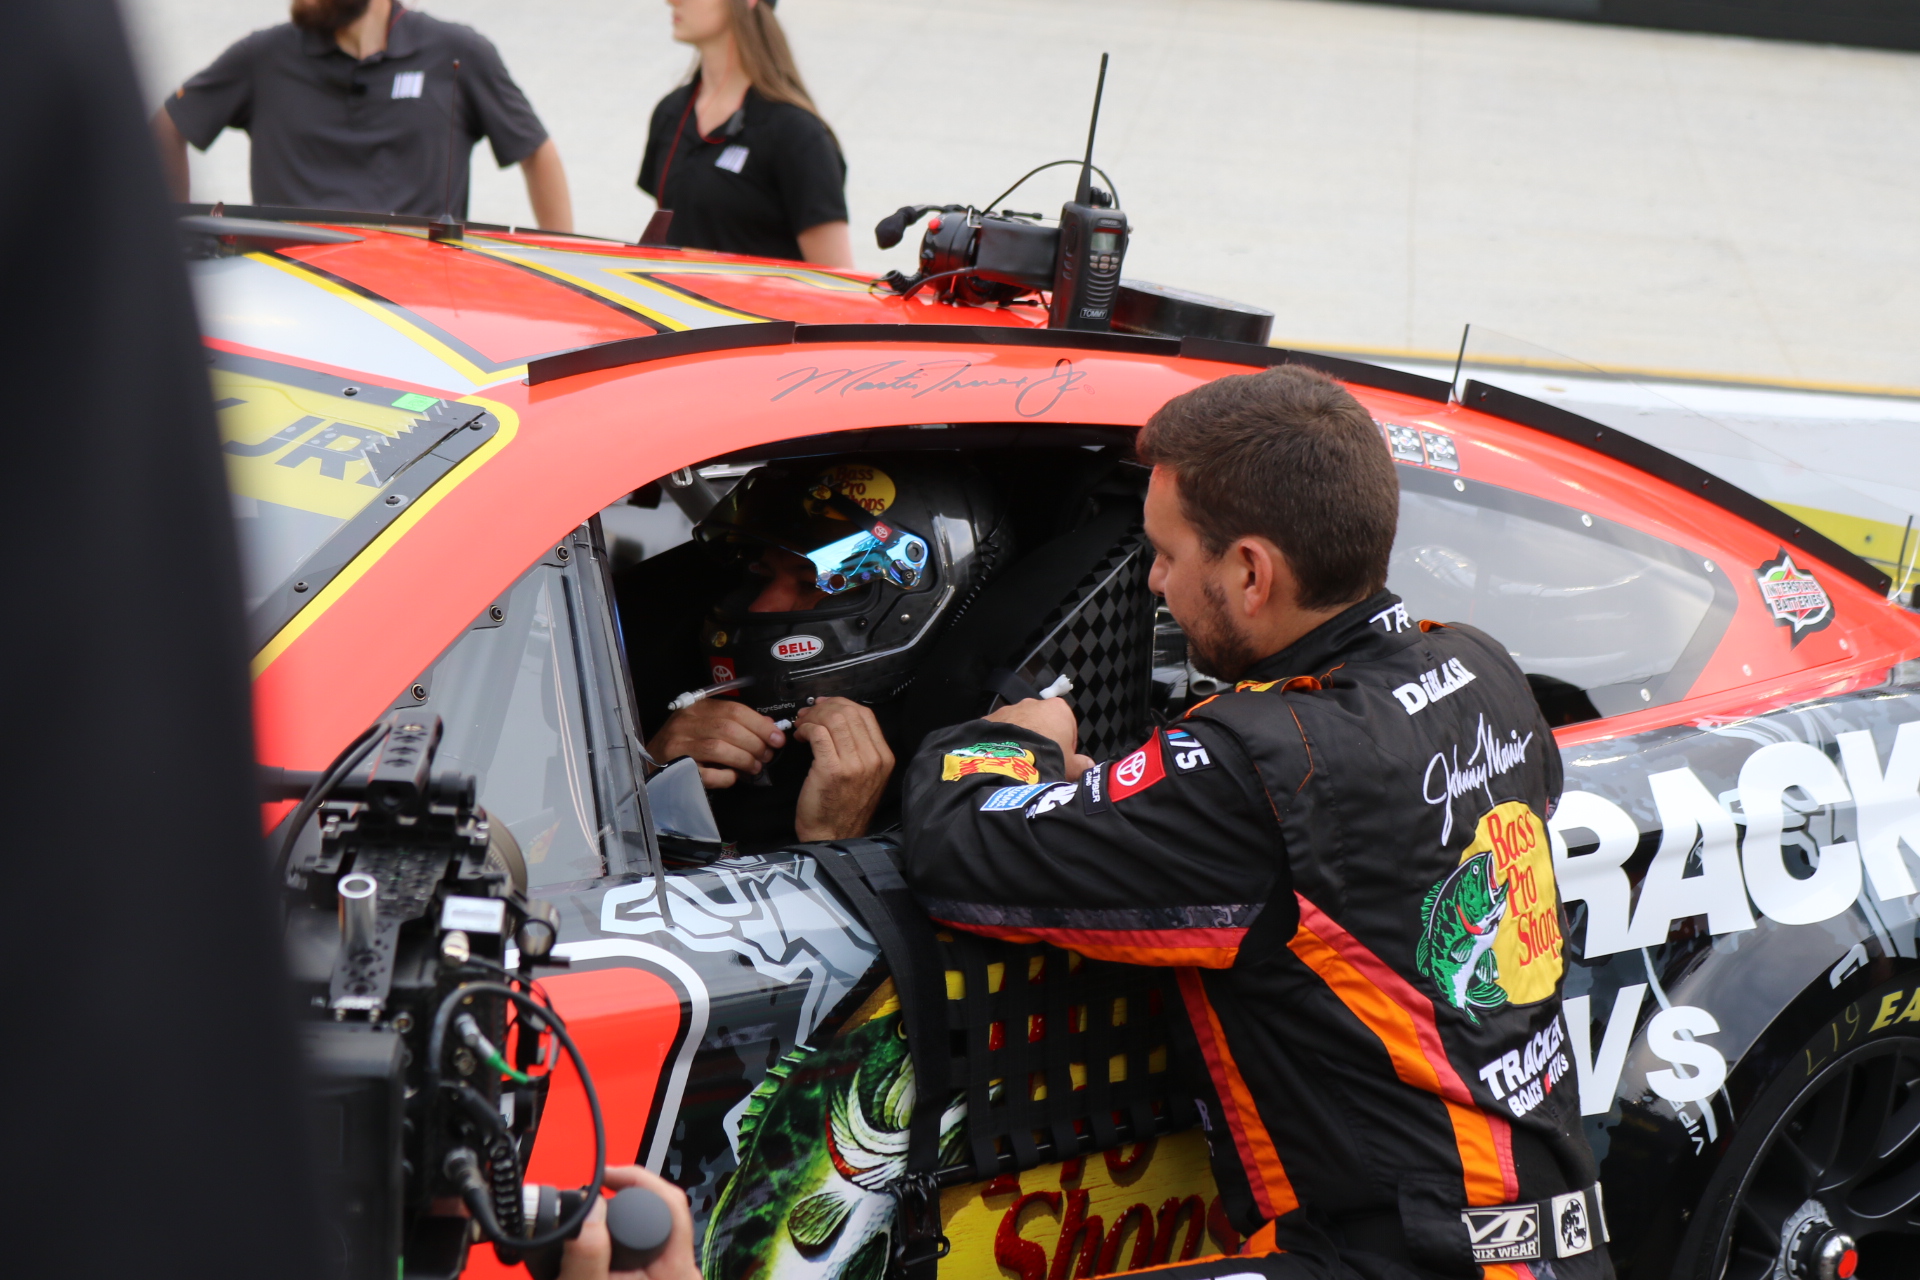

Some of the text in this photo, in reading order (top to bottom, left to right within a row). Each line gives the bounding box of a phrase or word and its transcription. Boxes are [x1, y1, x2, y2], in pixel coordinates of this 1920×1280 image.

[1082, 308, 1106, 318] TOMMY
[847, 494, 885, 512] hops
[1765, 581, 1820, 597] INTERSTATE
[1774, 594, 1826, 612] BATTERIES
[778, 641, 817, 655] BELL
[1487, 811, 1536, 870] Bass
[1507, 865, 1537, 918] Pro
[1518, 904, 1562, 967] Shops
[1479, 1014, 1564, 1100] TRACKER
[1508, 1077, 1544, 1117] BOATS
[1668, 1100, 1704, 1156] VIPE
[1498, 1242, 1537, 1259] WEAR
